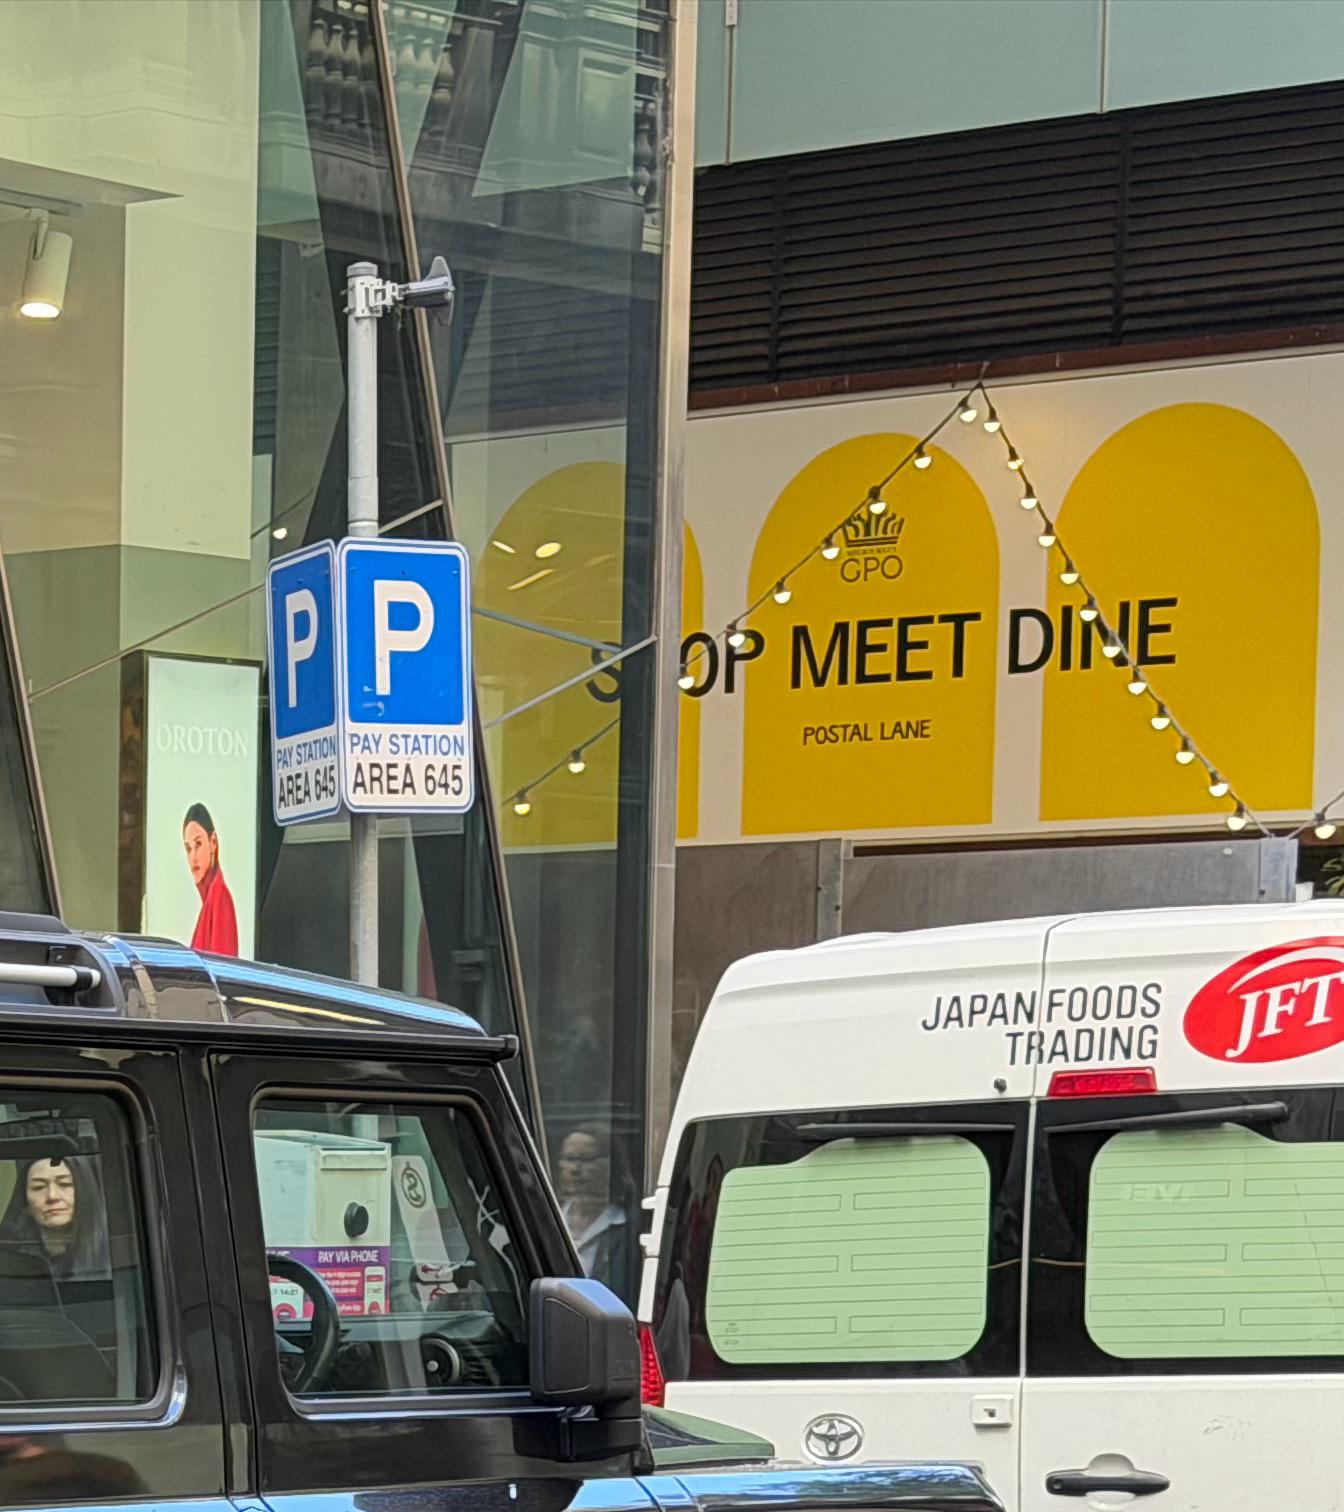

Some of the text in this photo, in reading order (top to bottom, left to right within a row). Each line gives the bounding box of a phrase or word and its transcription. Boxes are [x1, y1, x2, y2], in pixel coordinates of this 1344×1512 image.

[840, 554, 903, 583] GPO
[286, 588, 318, 708] P
[373, 579, 435, 695] P
[586, 597, 1178, 703] SOP MEET DINE
[156, 723, 249, 757] OROTON
[349, 733, 465, 757] PAY STATION
[802, 720, 933, 745] POSTAL LANE
[276, 735, 336, 769] PAY STATION
[278, 765, 336, 808] AREA 645
[352, 762, 464, 796] AREA 645
[921, 982, 1163, 1031] JAPAN FOODS
[1225, 973, 1344, 1058] JFT
[1005, 1023, 1159, 1066] TRADING
[318, 1249, 379, 1263] PAY VIA PHONE
